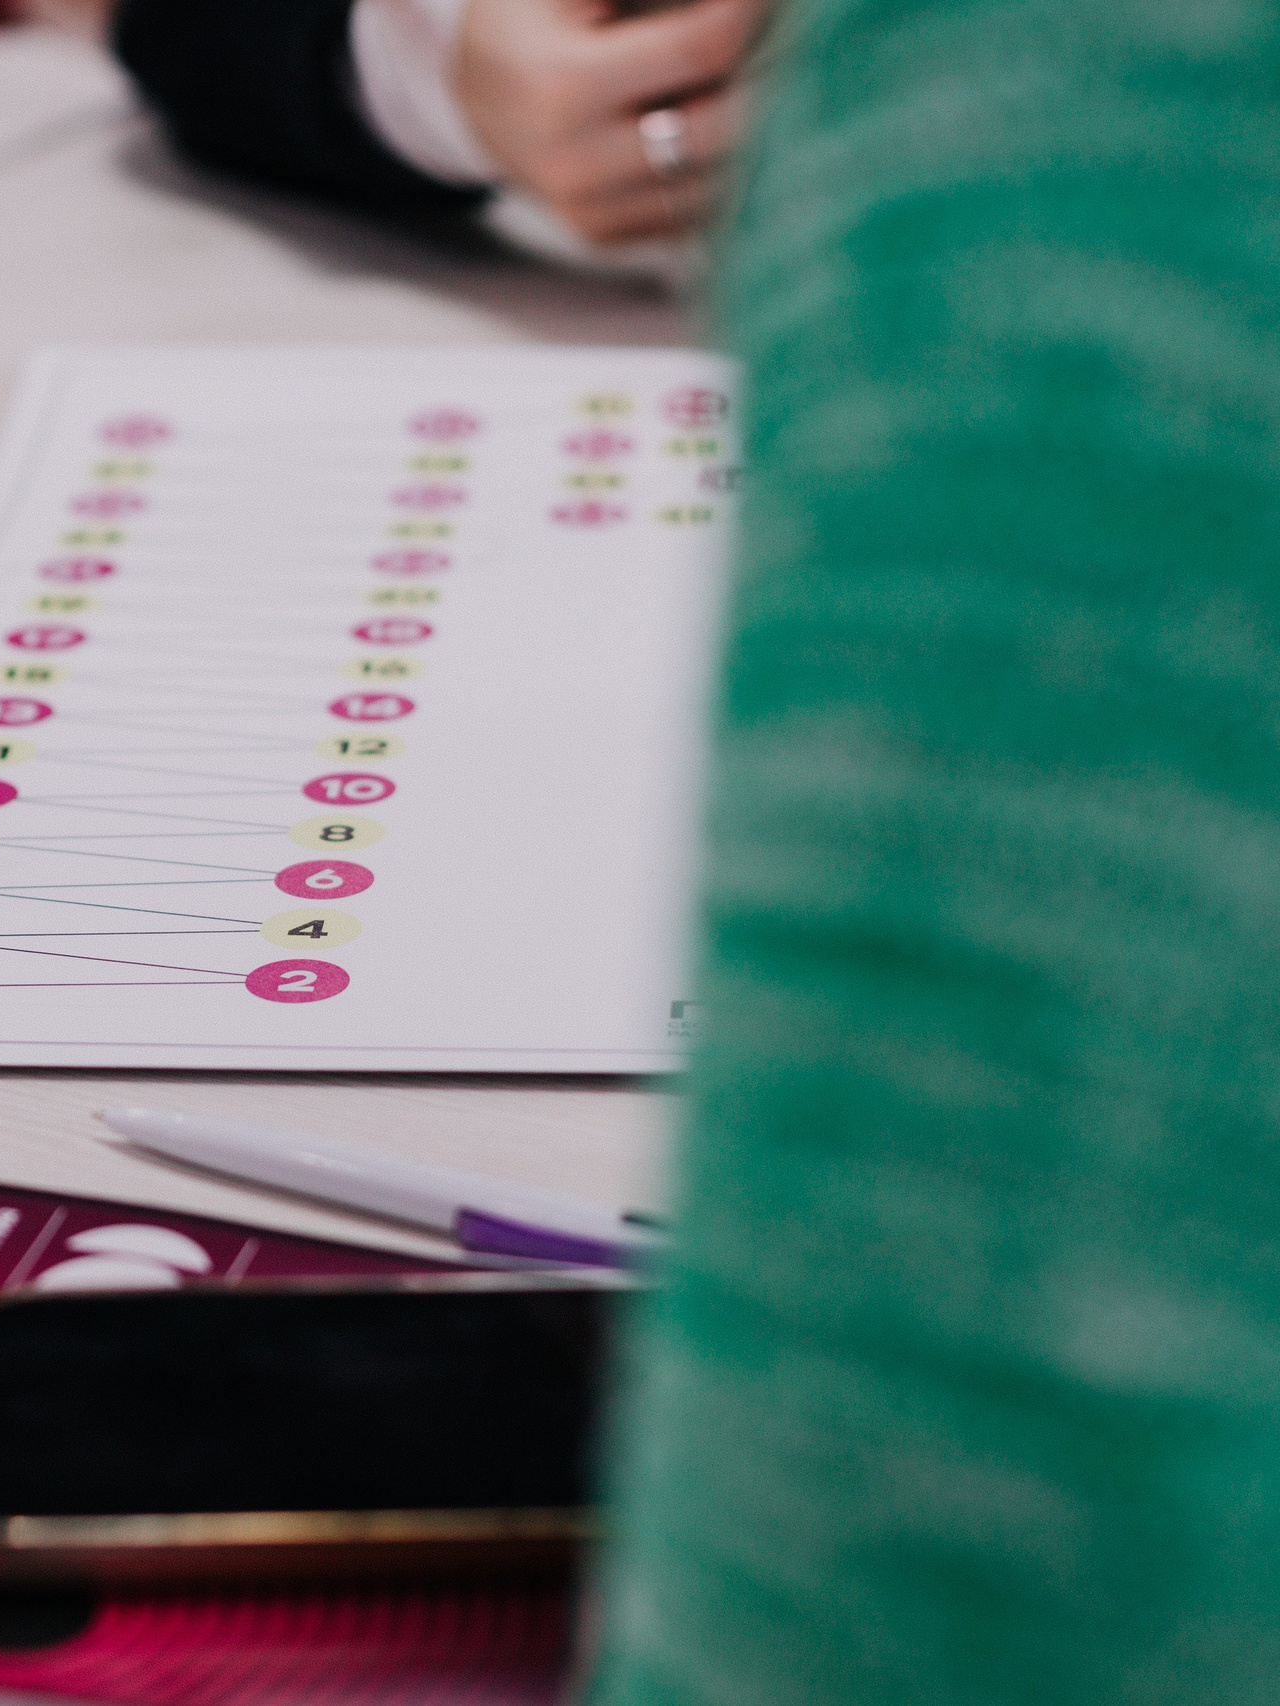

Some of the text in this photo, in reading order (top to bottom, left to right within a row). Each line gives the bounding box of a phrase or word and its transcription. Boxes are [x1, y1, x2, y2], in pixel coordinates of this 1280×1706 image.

[336, 739, 388, 756] 12
[321, 778, 385, 800] 10
[319, 824, 355, 843] 8
[304, 868, 344, 890] 6
[287, 919, 329, 939] 4
[276, 969, 319, 993] 2
